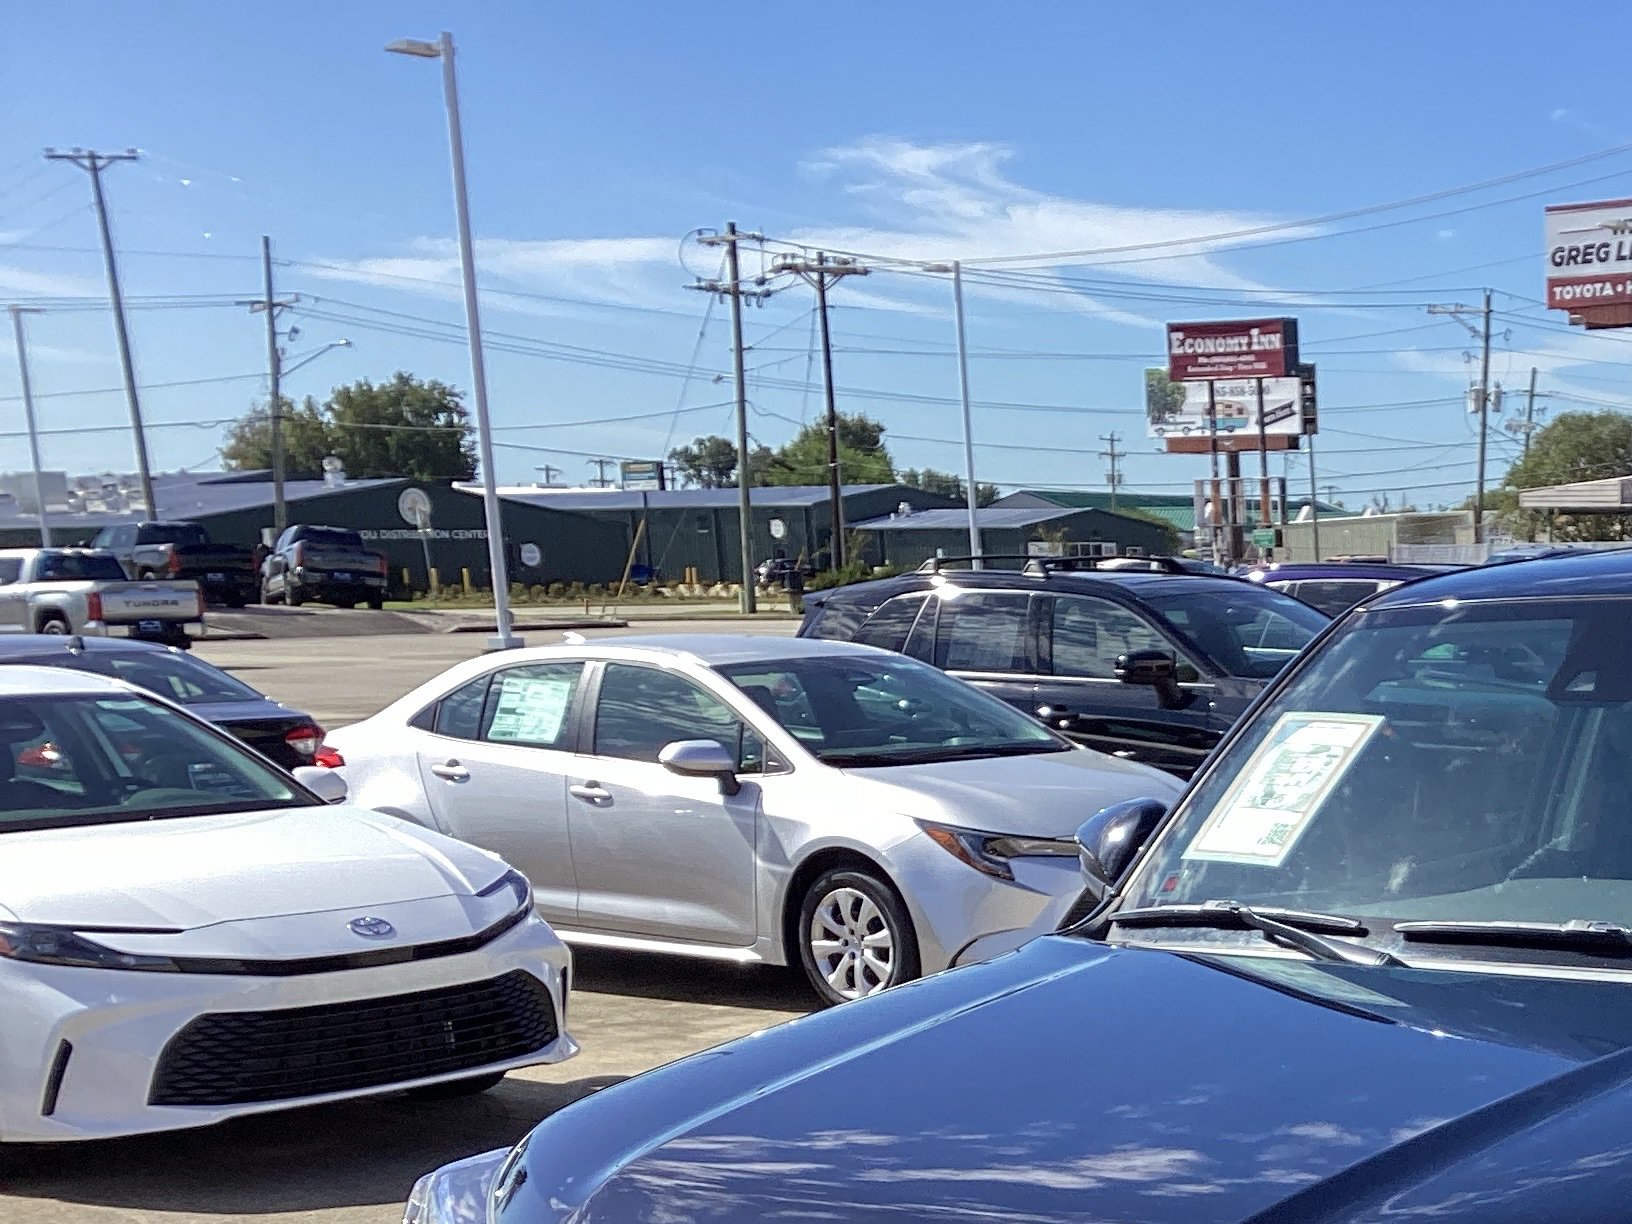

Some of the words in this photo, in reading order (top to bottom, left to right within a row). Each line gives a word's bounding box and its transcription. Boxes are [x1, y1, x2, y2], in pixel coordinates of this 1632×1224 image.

[1550, 241, 1611, 267] GREG
[1553, 281, 1615, 301] TOYOTA
[123, 599, 179, 607] TUNDRA
